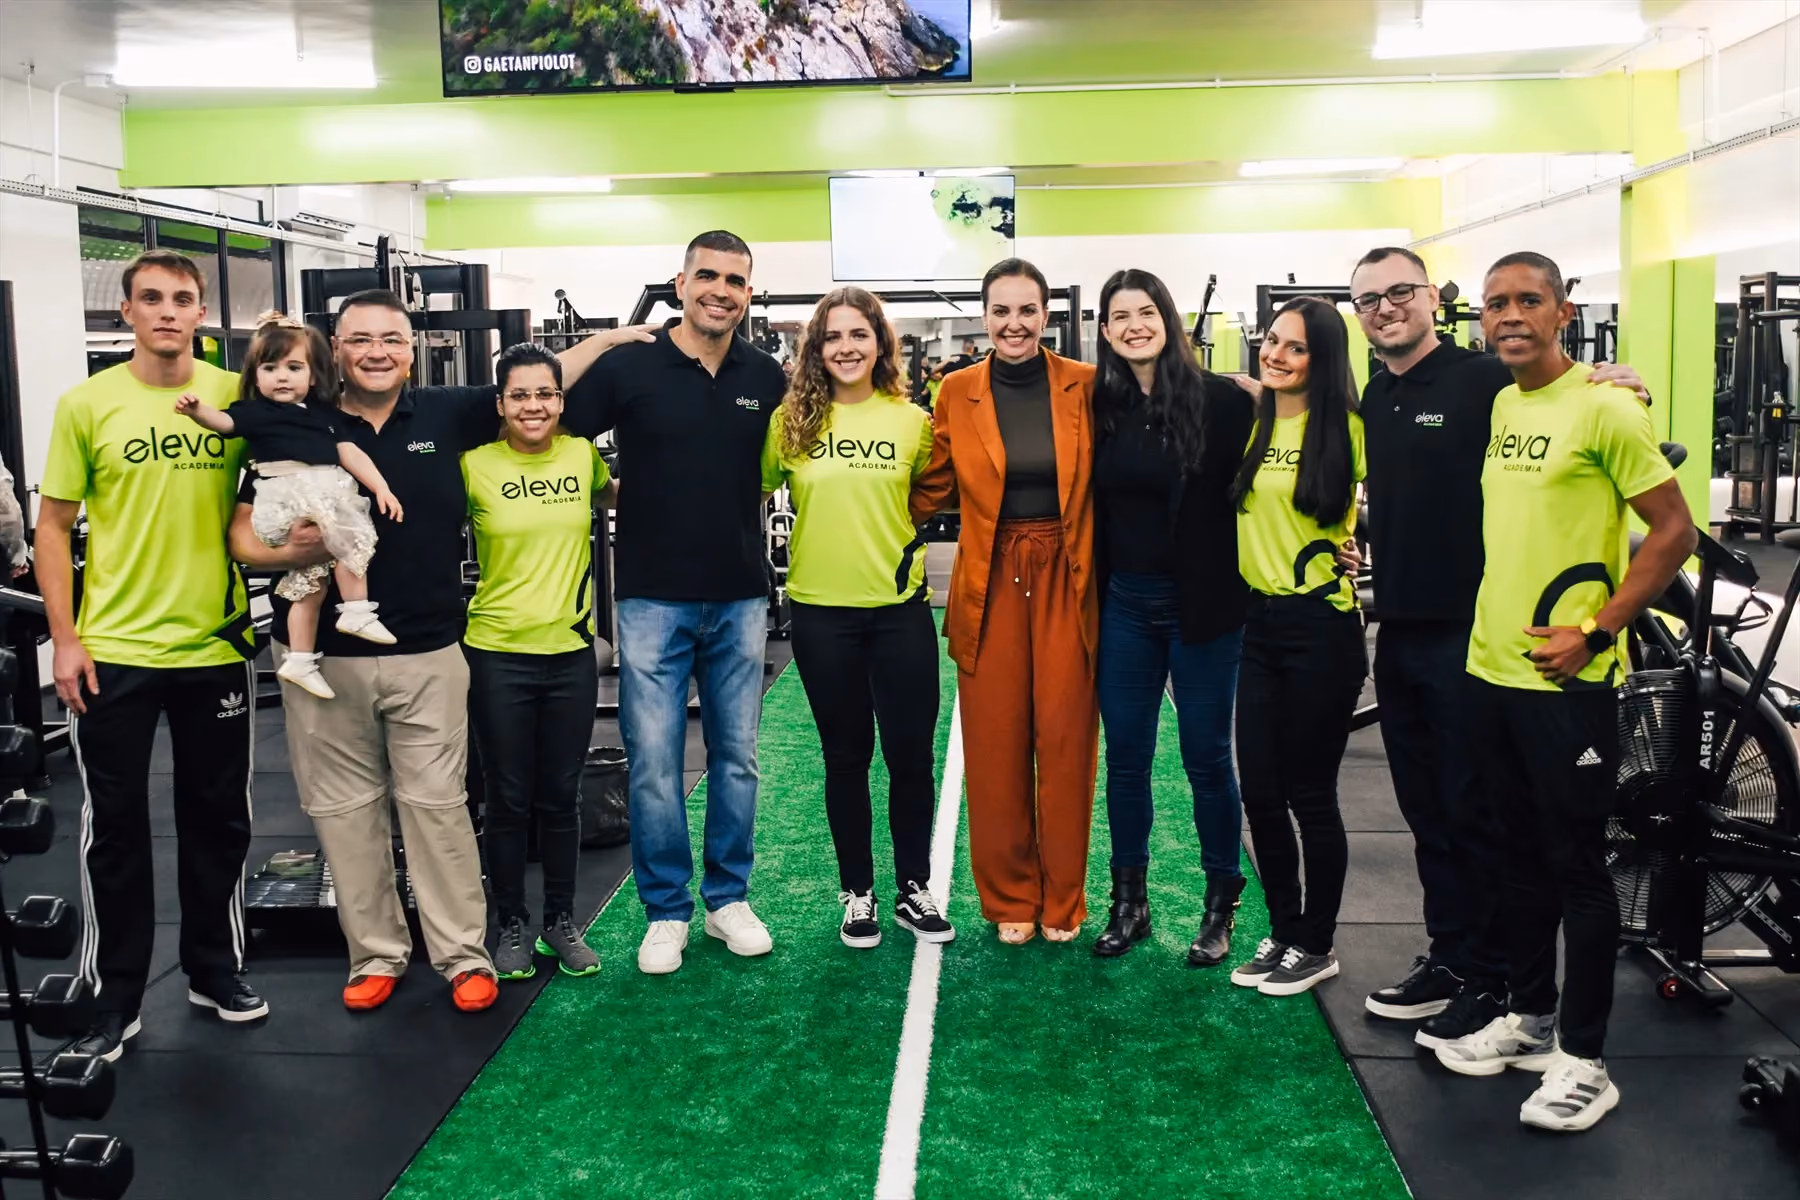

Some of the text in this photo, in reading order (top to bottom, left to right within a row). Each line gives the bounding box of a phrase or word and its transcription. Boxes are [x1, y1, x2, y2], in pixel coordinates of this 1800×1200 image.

[483, 54, 576, 72] GAETANPIOLOT
[122, 426, 225, 464] eleva
[1262, 447, 1302, 465] eva
[173, 462, 225, 470] ACADEMIA
[848, 462, 897, 471] ACADEMIA
[501, 475, 581, 500] eleva
[541, 496, 582, 505] ACADEMIA
[1699, 711, 1716, 770] AR501
[1576, 758, 1602, 766] adidas
